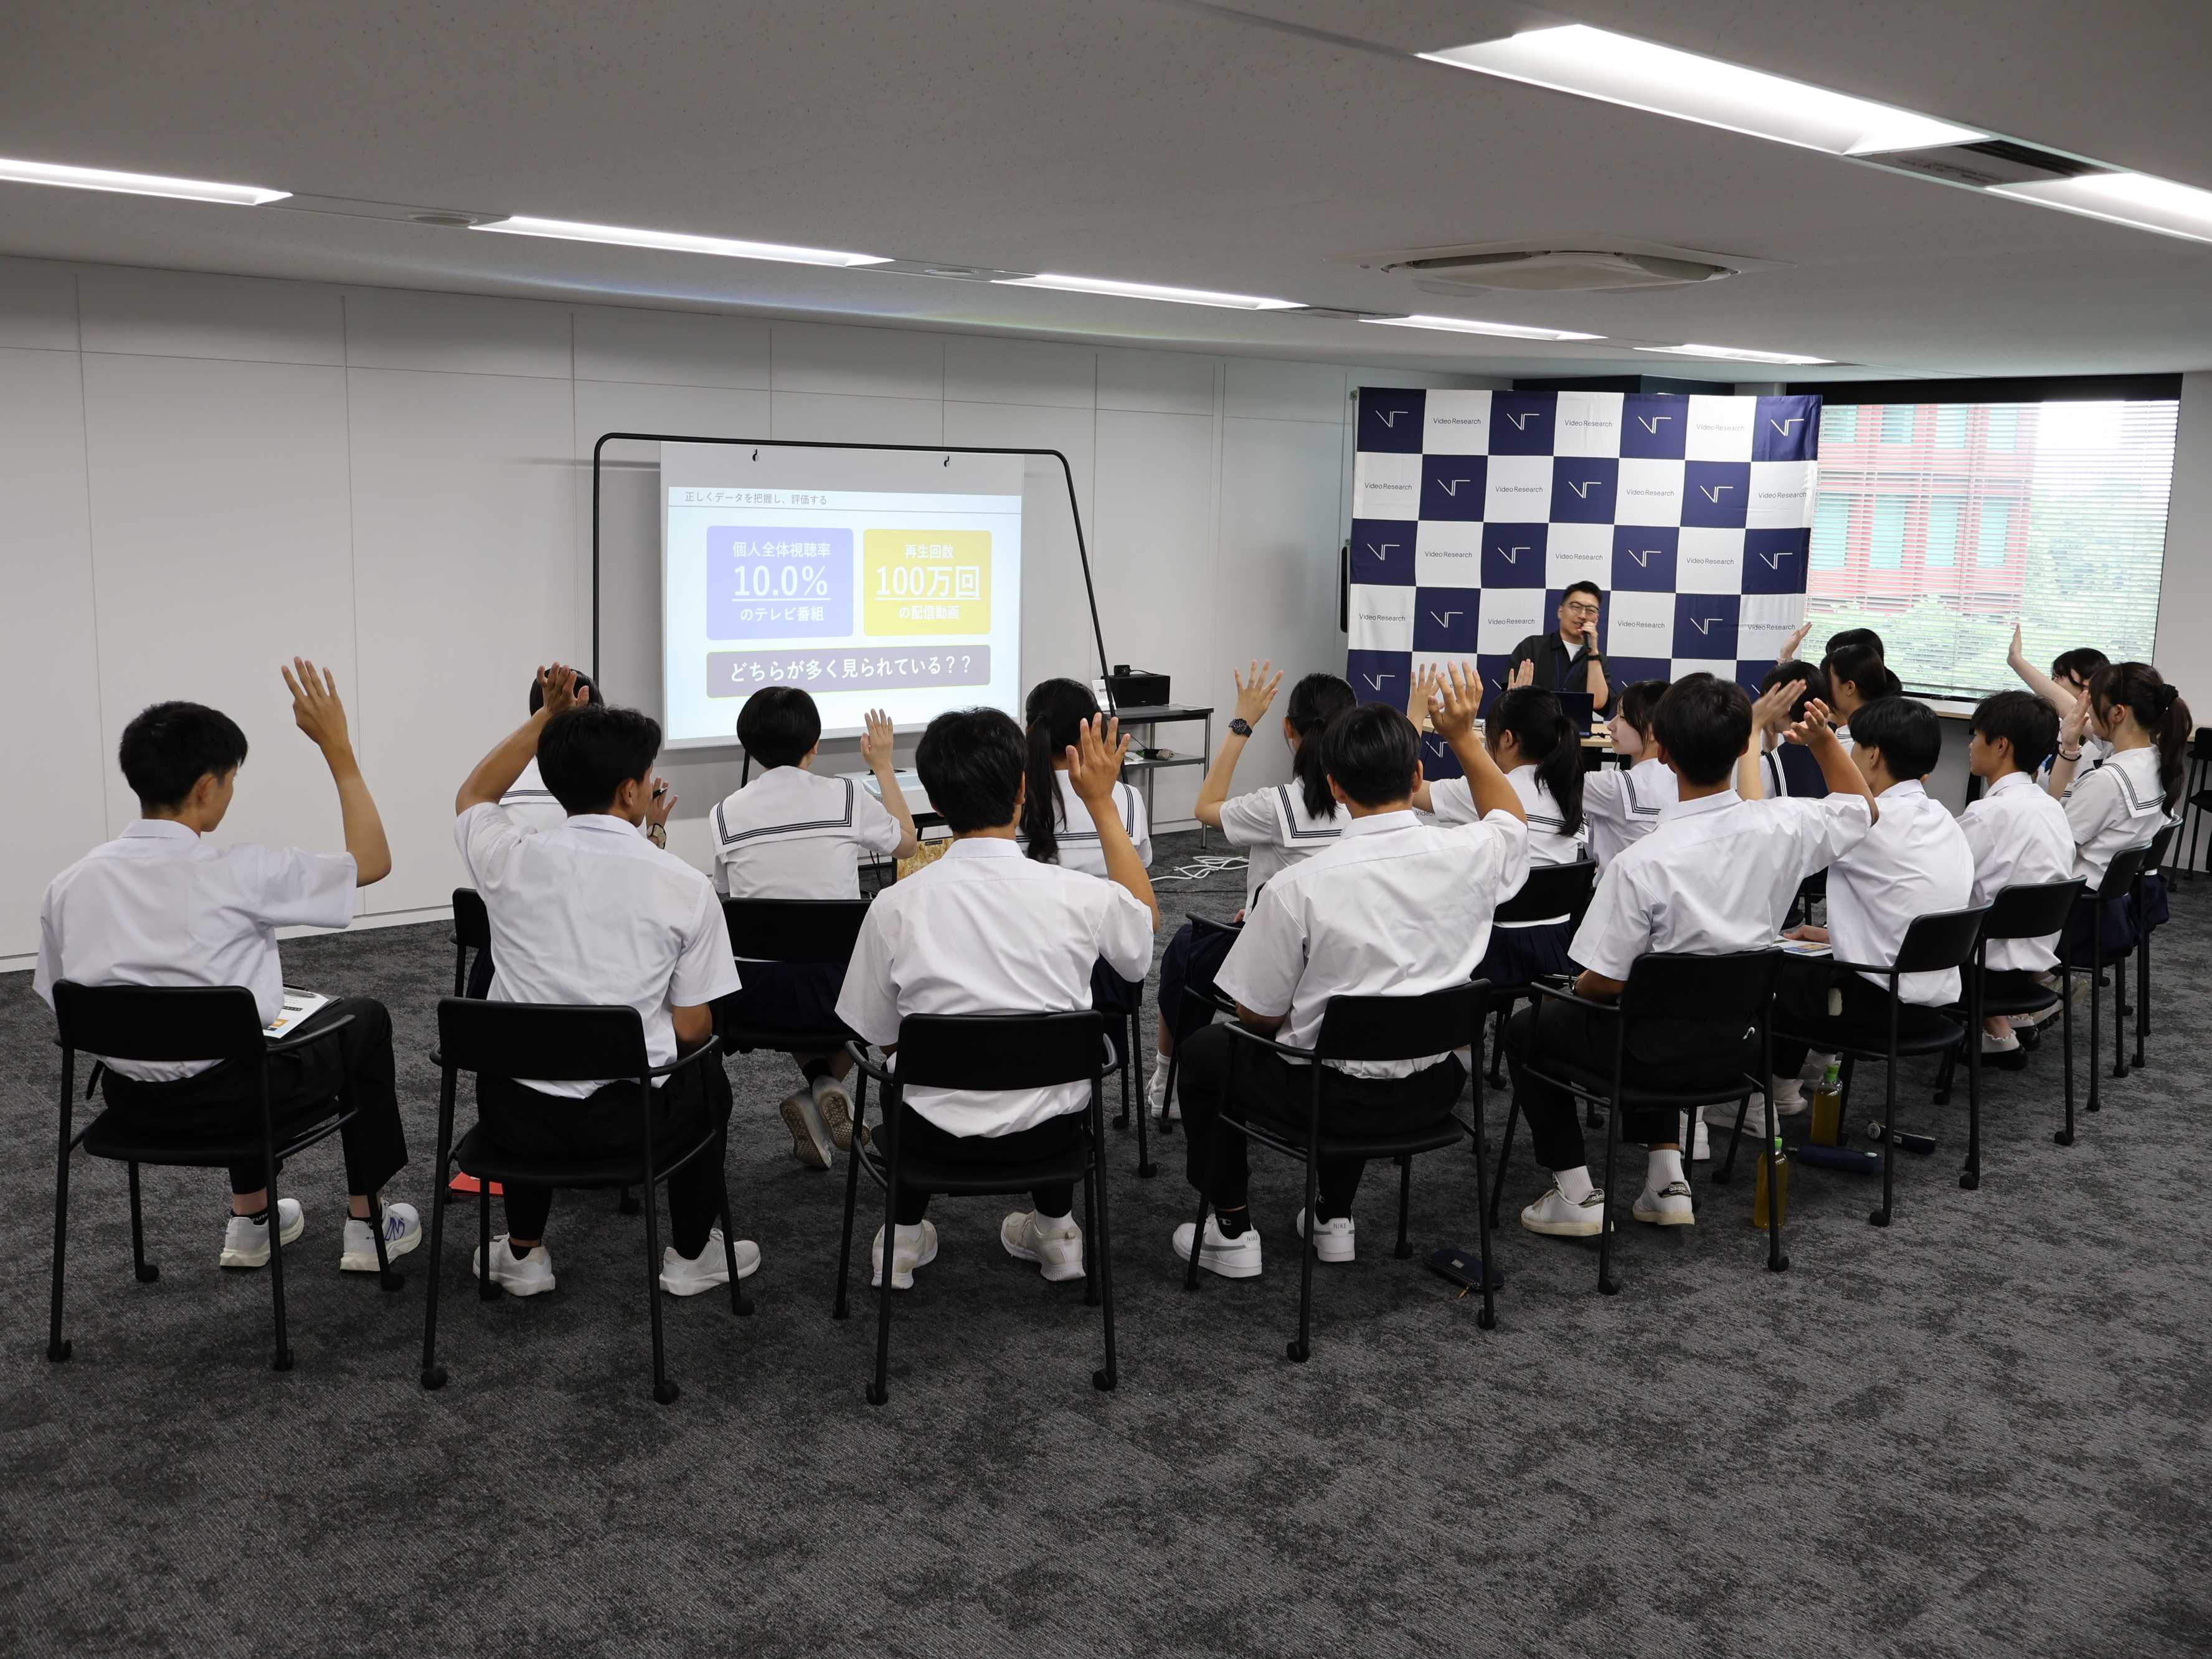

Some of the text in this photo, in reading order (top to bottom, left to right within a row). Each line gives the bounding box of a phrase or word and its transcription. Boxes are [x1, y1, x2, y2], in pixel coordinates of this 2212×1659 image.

[685, 491, 827, 505] 正しくデータを把握し、評価する
[732, 541, 831, 557] 個人全体視聴率
[905, 544, 953, 559] 再生回数
[734, 565, 828, 596] 10.0%
[876, 565, 980, 598] 100万回
[740, 607, 825, 622] のテレビ番組
[899, 605, 960, 620] の配信動画
[1333, 1222, 1347, 1230] NIKE
